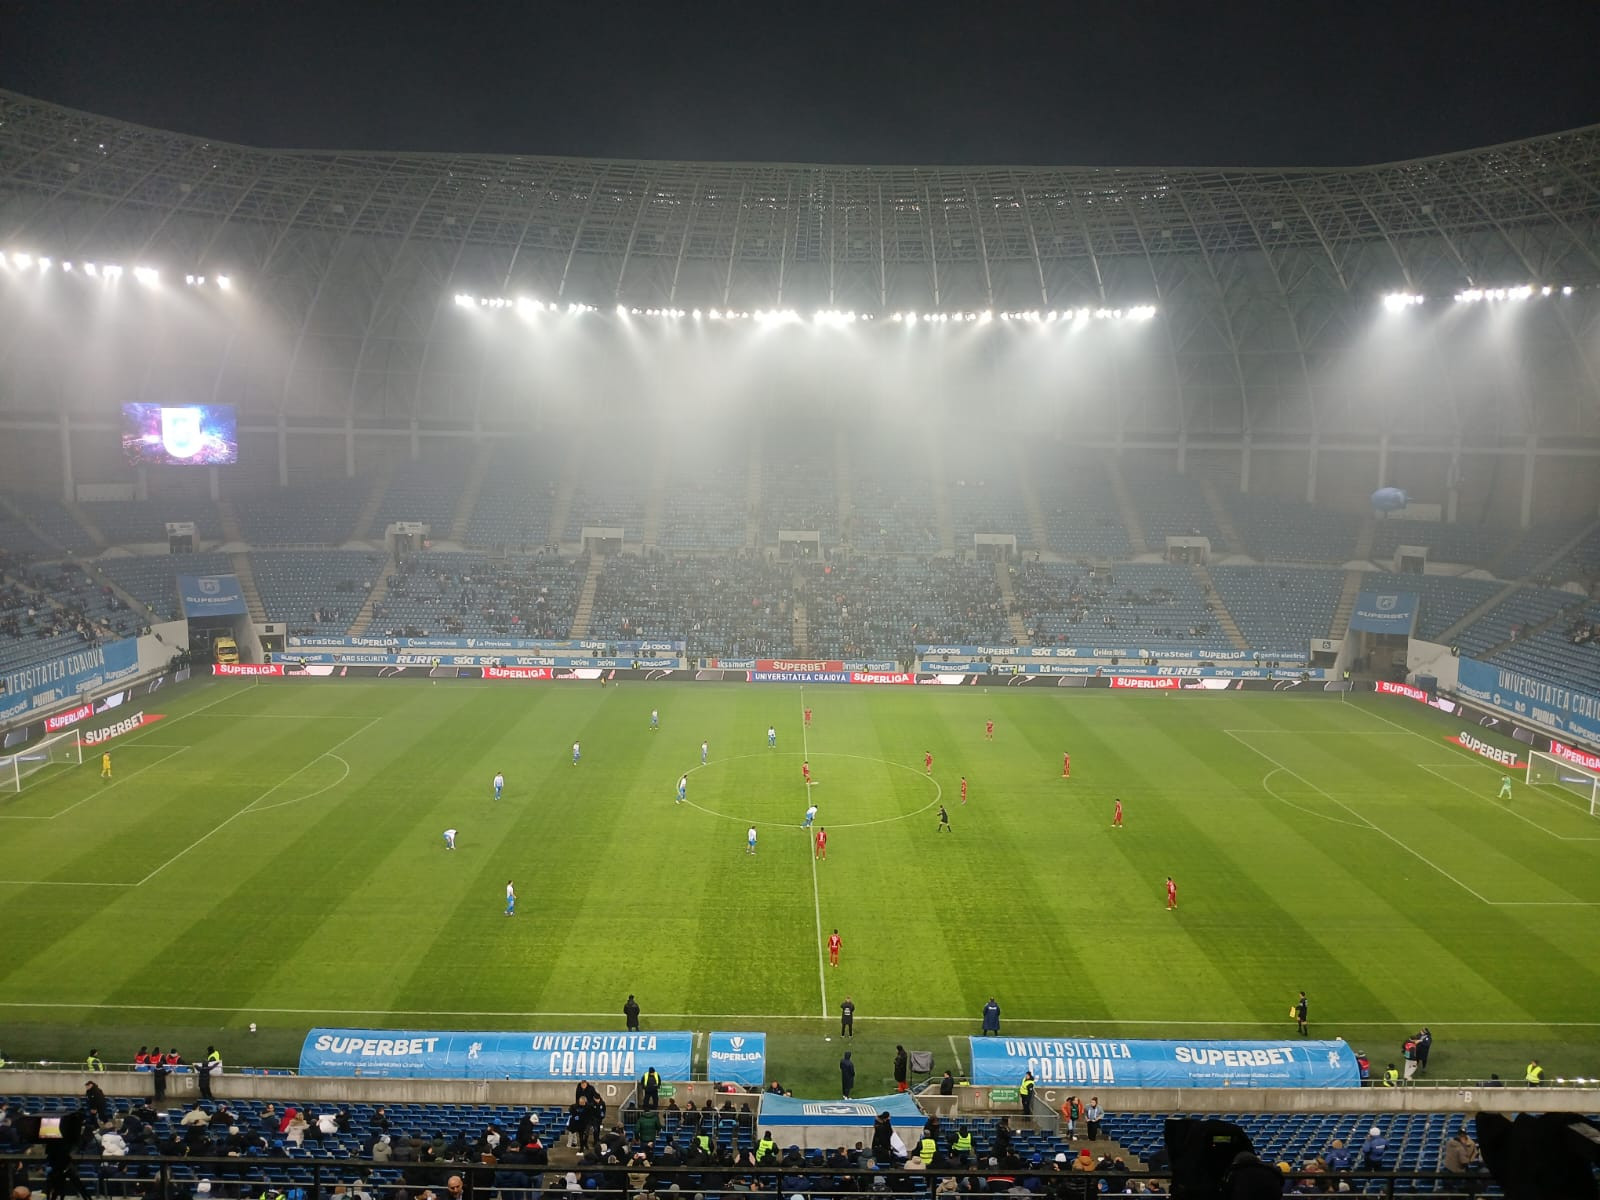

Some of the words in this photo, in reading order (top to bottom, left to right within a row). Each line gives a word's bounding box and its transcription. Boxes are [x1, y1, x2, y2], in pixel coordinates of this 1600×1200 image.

[303, 638, 345, 646] TeraSteel
[351, 637, 399, 647] SUPERLIGA
[977, 646, 1020, 656] SUPERBET
[1150, 650, 1193, 658] TeraSteel
[1198, 650, 1246, 660] SUPERLIGA
[68, 648, 104, 676] CRAIOVA
[356, 655, 388, 663] SECURITY
[220, 664, 277, 675] SUPERLIGA
[772, 661, 827, 672] SUPERBET
[1157, 667, 1204, 676] RURIS
[489, 667, 546, 679] SUPERLIGA
[755, 671, 811, 681] UNIVERSITATEA
[814, 672, 846, 681] CRAIOVA
[853, 673, 909, 684] SUPERLIGA
[1117, 678, 1174, 689] SUPERLIGA
[1499, 670, 1570, 711] UNIVERSITATEA
[50, 706, 90, 728] SUPERLIGA
[85, 711, 145, 745] SUPERBET
[1458, 732, 1518, 766] SUPERBET
[314, 1035, 440, 1057] SUPERBET
[532, 1035, 657, 1051] UNIVERSITATEA
[1005, 1040, 1132, 1059] UNIVERSITATEA
[711, 1051, 762, 1061] SUPERLIGA
[1175, 1046, 1295, 1066] SUPERBET
[549, 1051, 635, 1076] CRAIOVA
[1028, 1057, 1115, 1083] CRAIOVA
[606, 1084, 617, 1097] D
[1045, 1091, 1056, 1102] C
[1464, 1091, 1473, 1103] B
